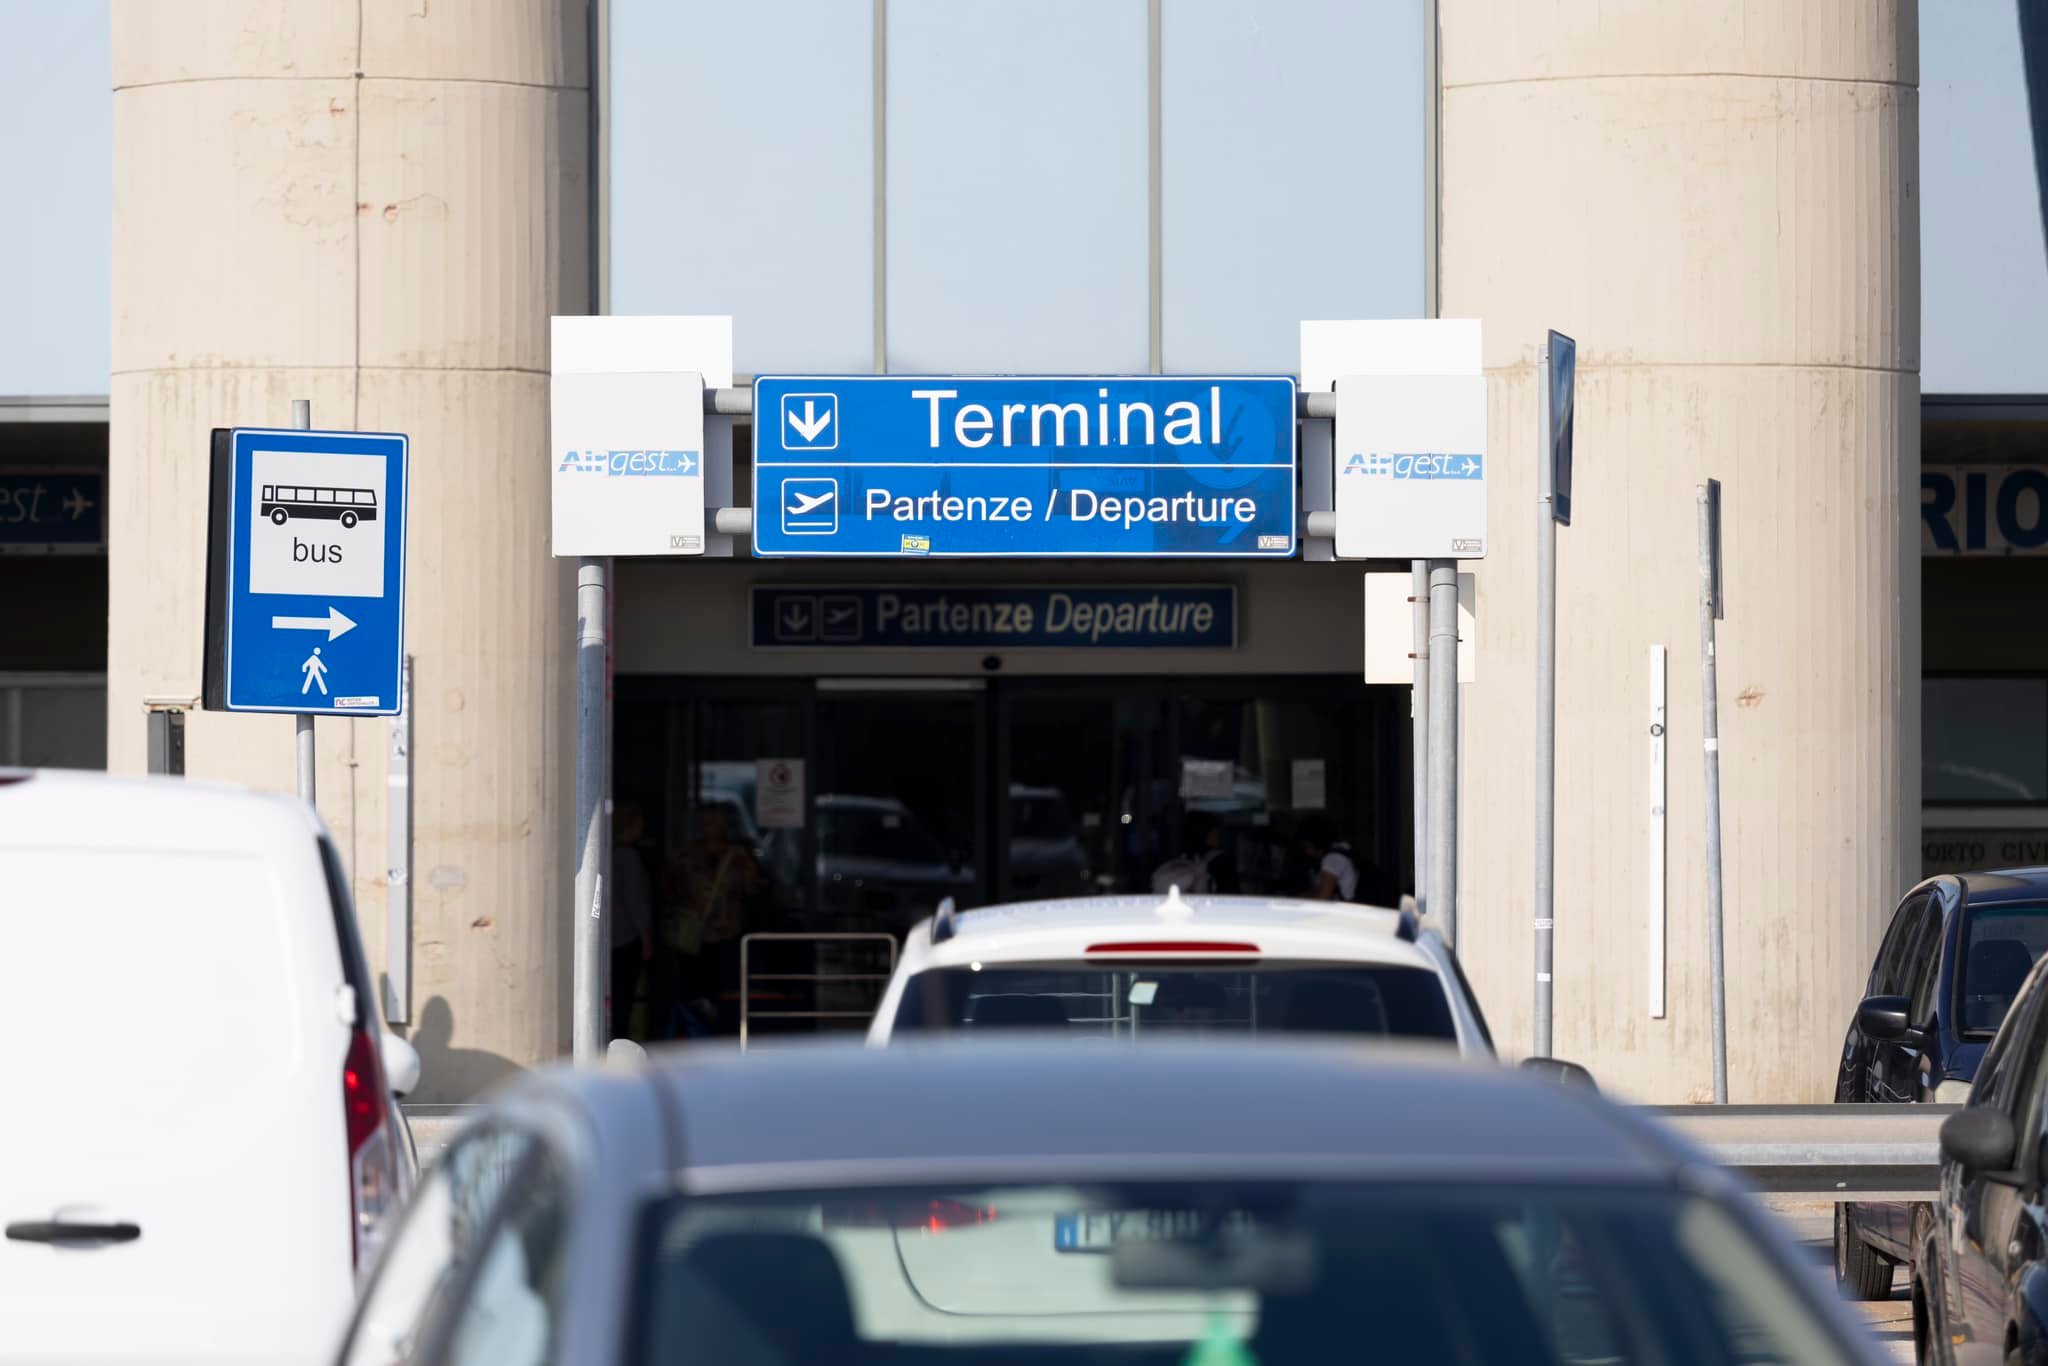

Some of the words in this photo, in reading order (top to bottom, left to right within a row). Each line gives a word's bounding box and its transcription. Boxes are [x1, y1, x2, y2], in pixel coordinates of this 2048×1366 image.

[911, 386, 1221, 448] Terminal
[866, 488, 1033, 522] Partenze
[1045, 488, 1058, 521] /
[1071, 489, 1256, 530] Departure
[293, 536, 343, 564] bus
[877, 594, 1034, 632] Partenze
[1044, 593, 1214, 644] Departure
